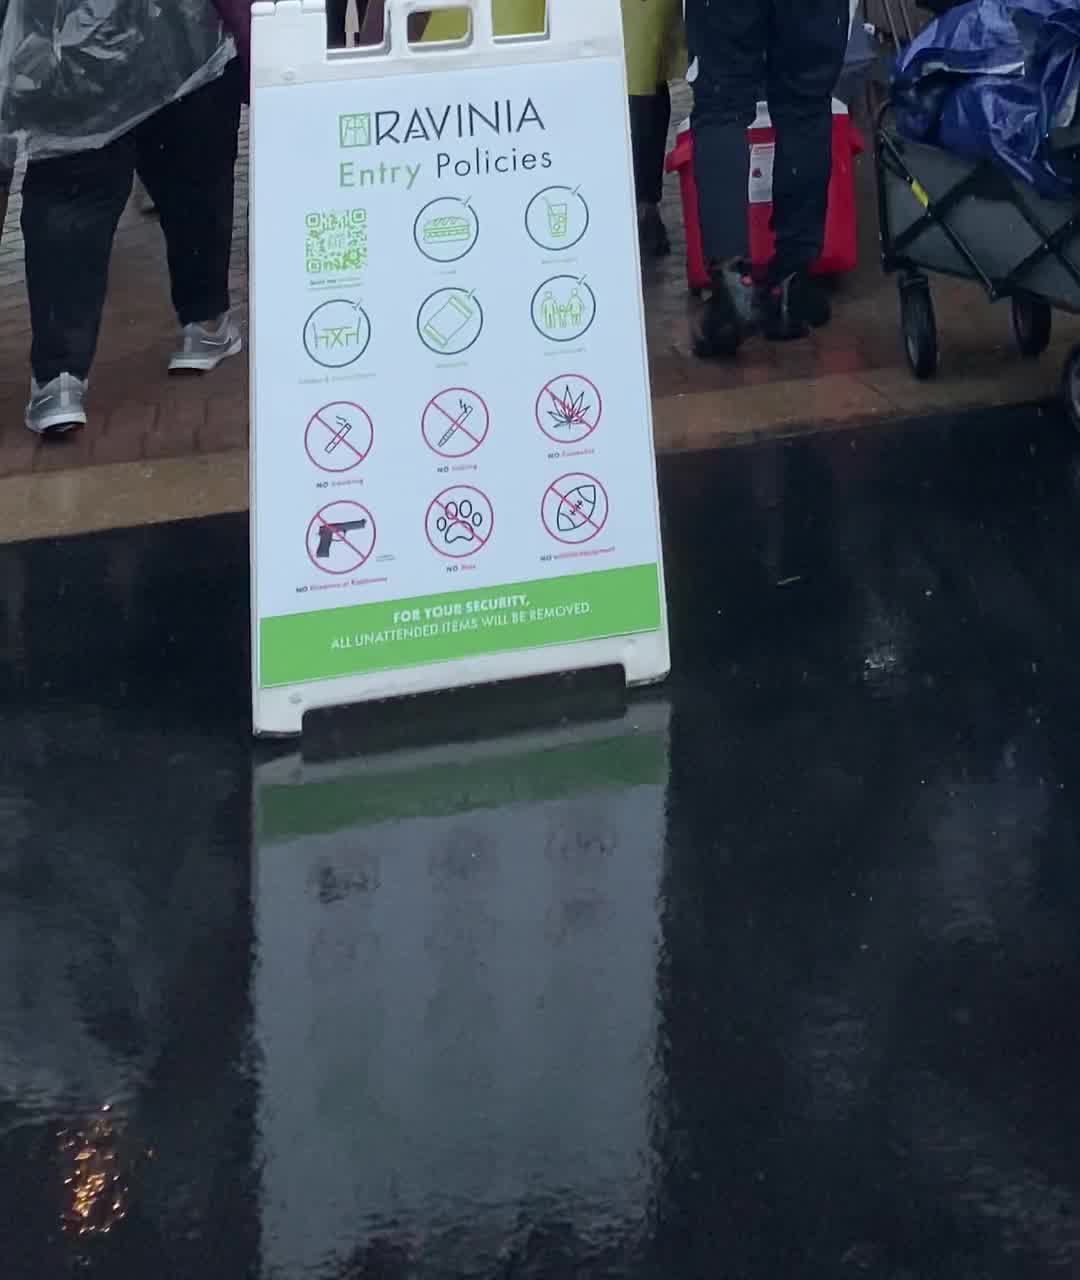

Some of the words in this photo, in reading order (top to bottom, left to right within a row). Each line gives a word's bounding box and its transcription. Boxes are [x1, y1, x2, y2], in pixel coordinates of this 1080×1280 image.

[375, 96, 546, 146] RAVINIA
[339, 161, 422, 191] Entry
[436, 146, 553, 179] Policies
[330, 635, 353, 649] ALL
[354, 622, 439, 647] UNATTENDED
[442, 617, 479, 634] ITEMS
[481, 615, 509, 627] WILL
[511, 610, 527, 625] BE
[392, 607, 421, 624] FOR
[423, 602, 462, 620] YOUR
[465, 593, 531, 614] SECURITY,
